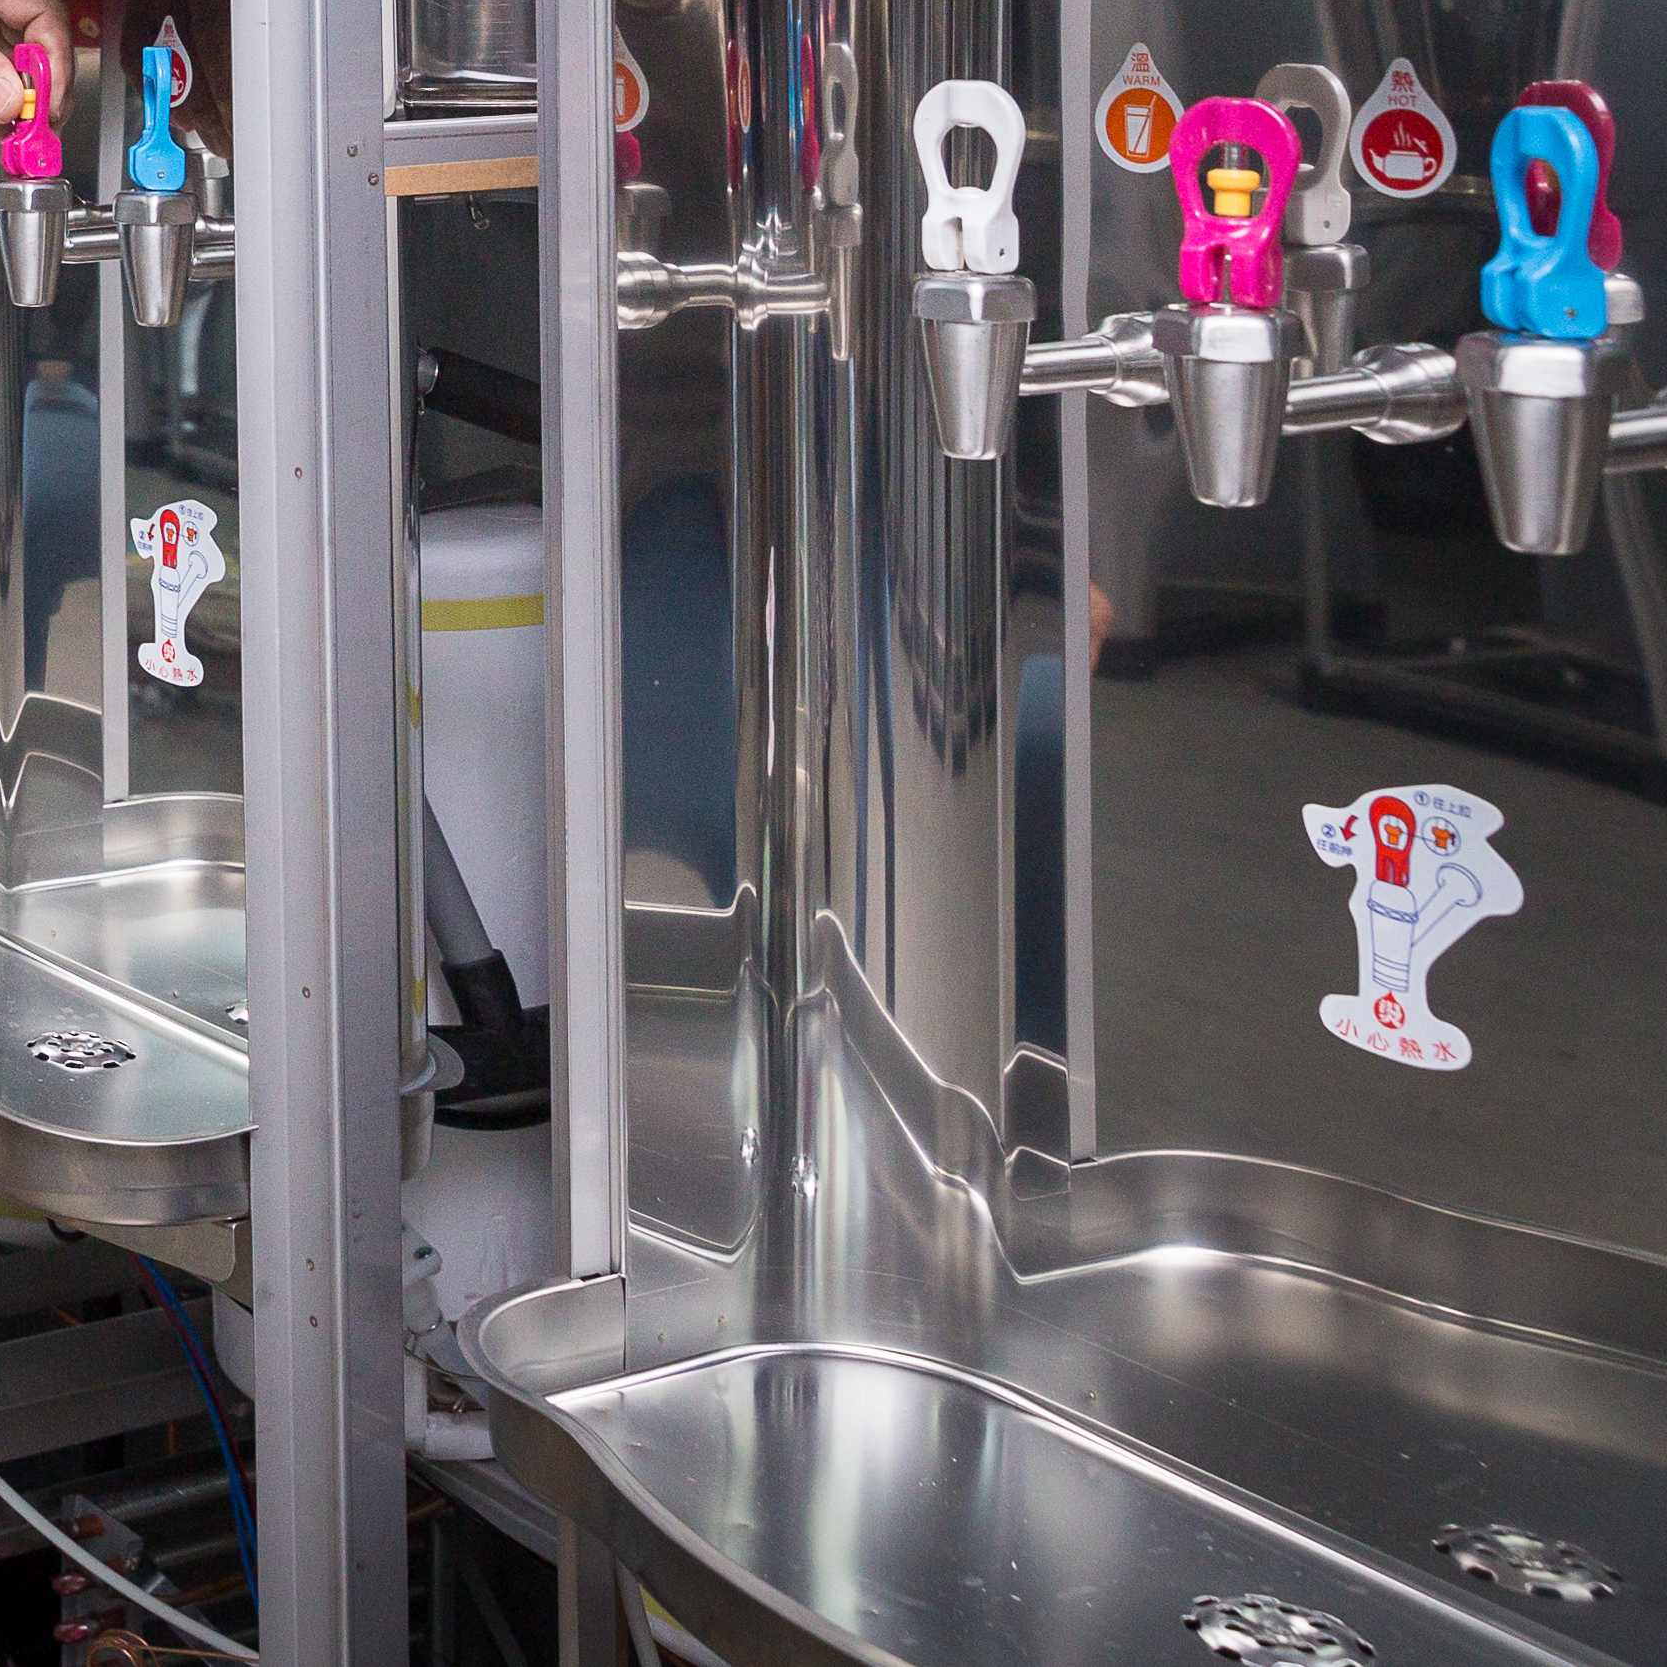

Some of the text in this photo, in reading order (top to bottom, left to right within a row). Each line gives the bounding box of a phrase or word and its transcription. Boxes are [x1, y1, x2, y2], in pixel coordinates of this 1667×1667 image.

[1122, 75, 1161, 86] WARM
[1387, 95, 1417, 107] HOT
[1335, 1018, 1458, 1063] 小心熱水
